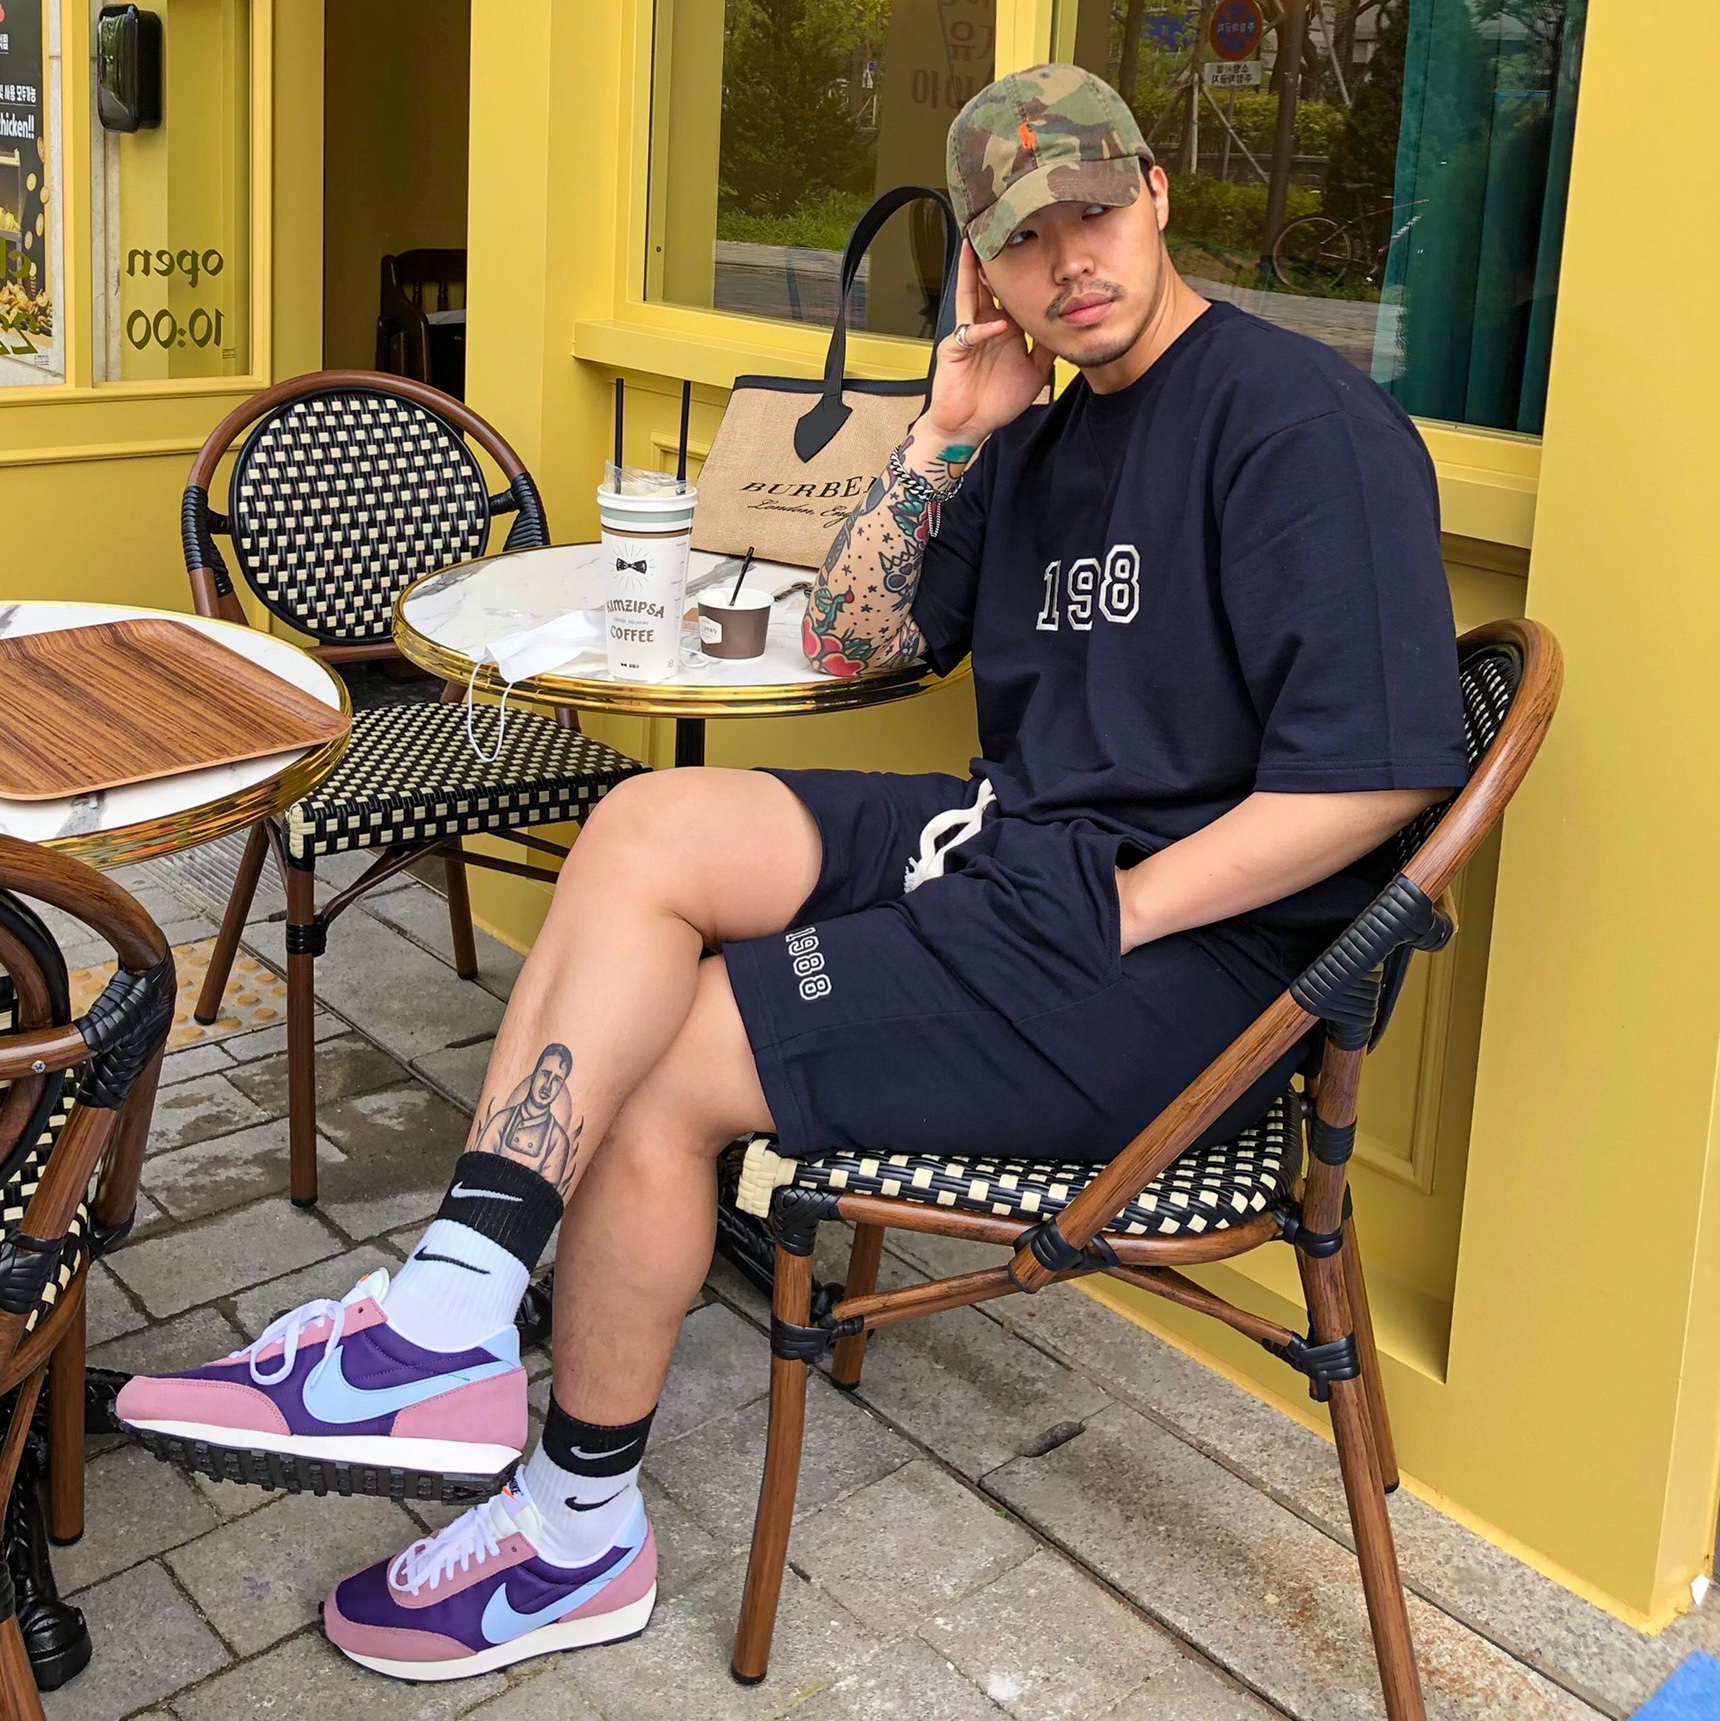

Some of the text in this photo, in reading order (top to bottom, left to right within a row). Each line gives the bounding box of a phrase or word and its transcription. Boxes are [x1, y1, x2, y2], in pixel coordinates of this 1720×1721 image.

[16, 85, 36, 103] 모두가능
[820, 505, 850, 528] Eng
[1036, 544, 1140, 631] 198
[610, 625, 655, 642] COFFEE
[785, 927, 832, 1000] 1988
